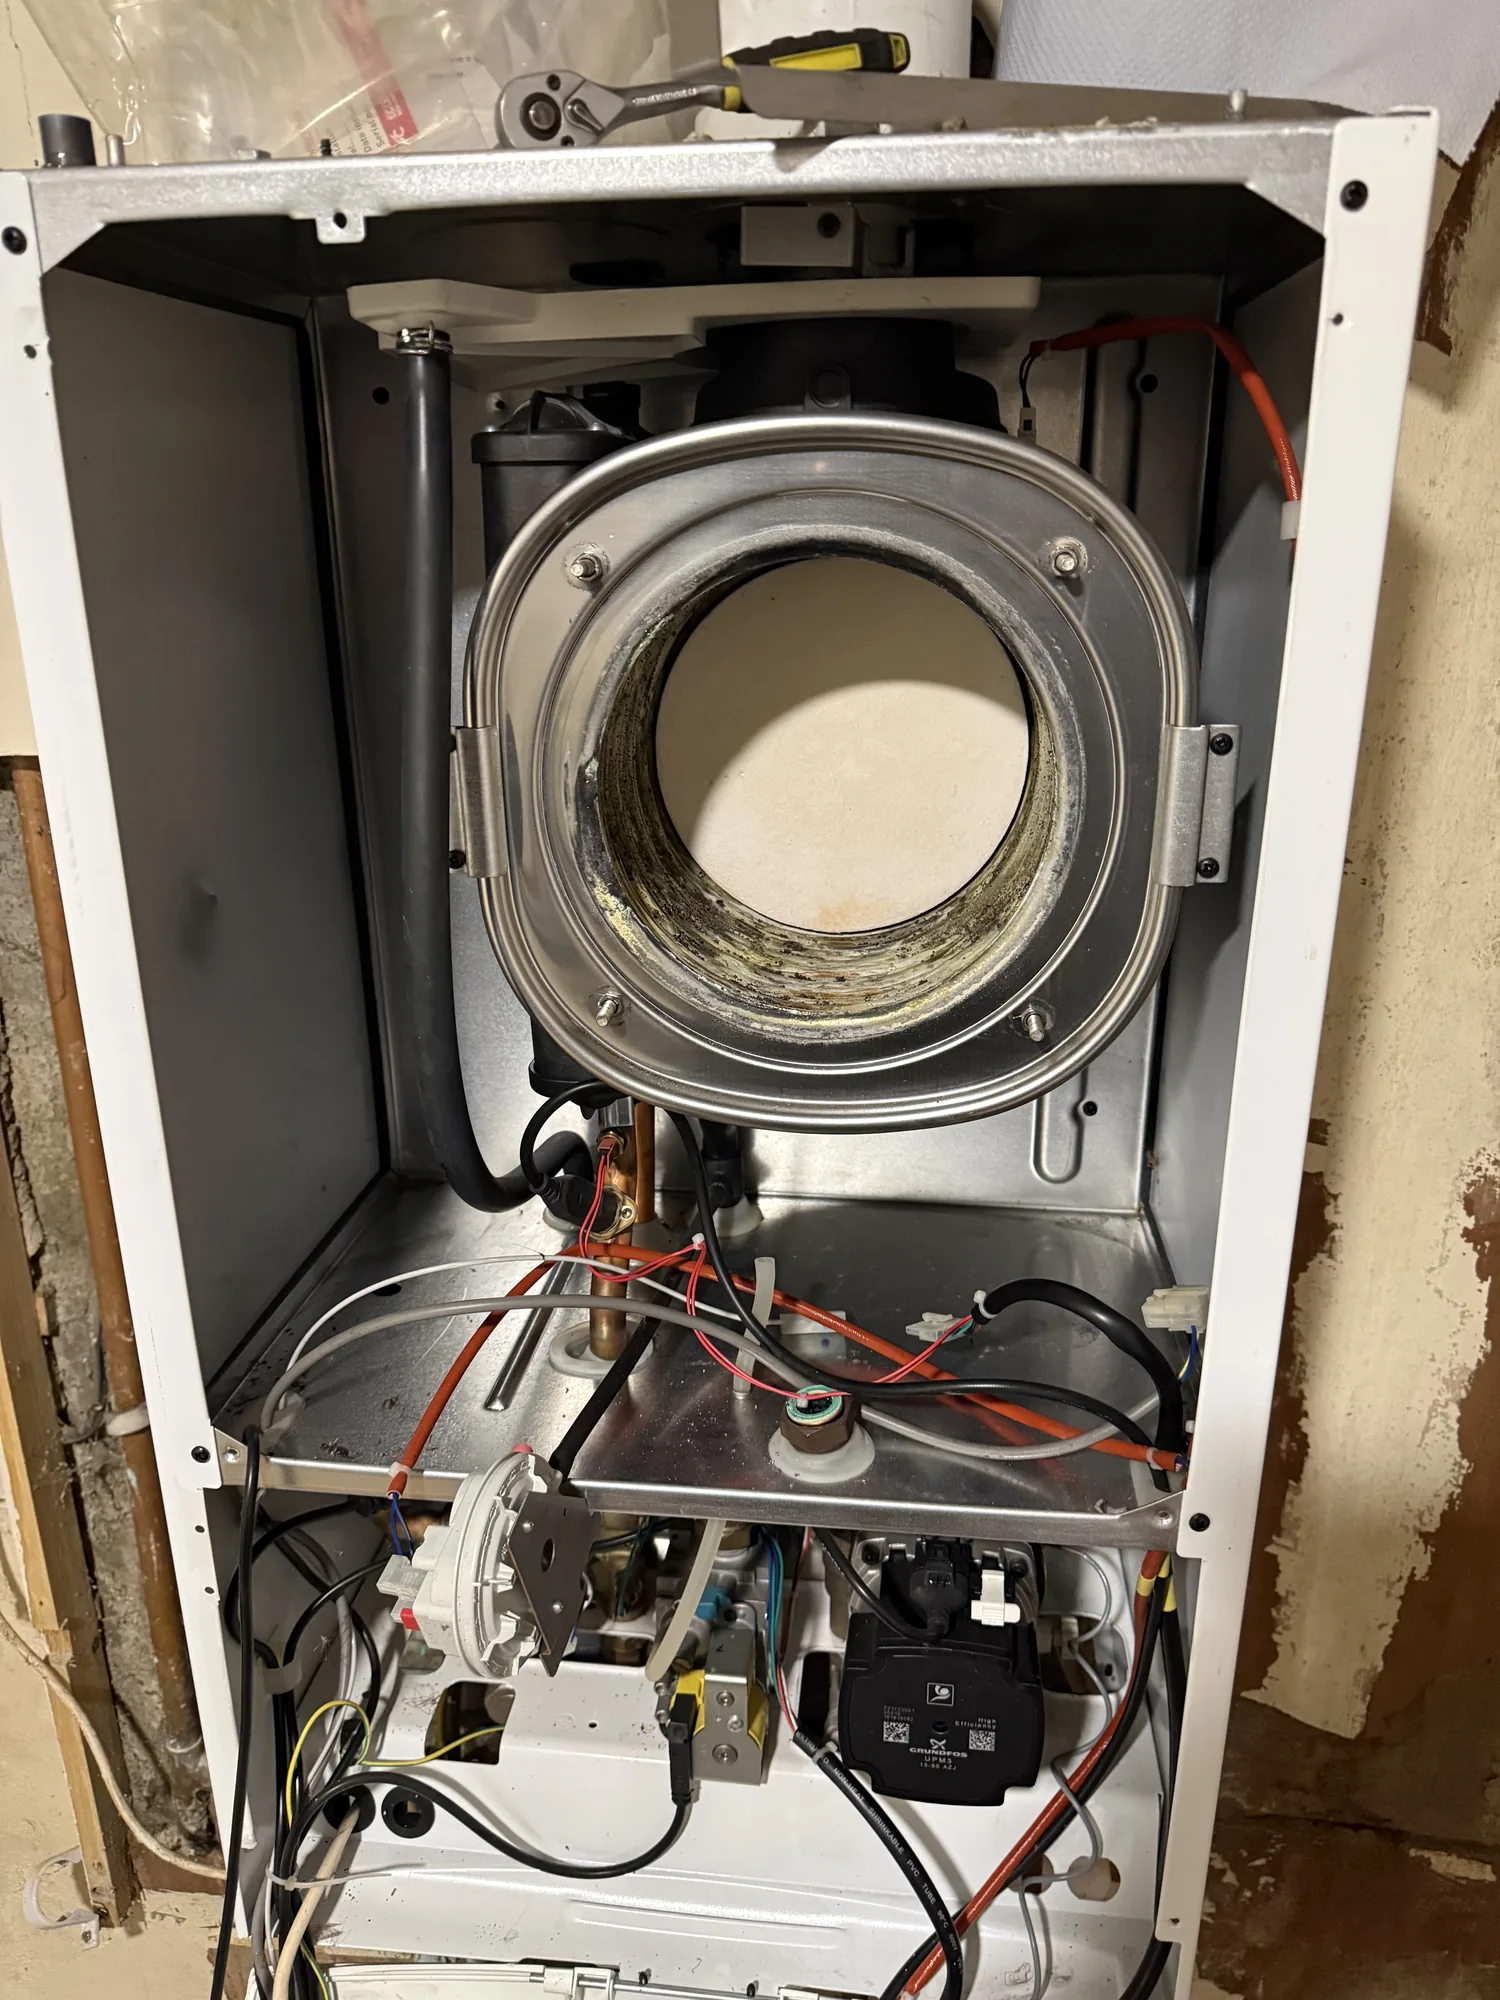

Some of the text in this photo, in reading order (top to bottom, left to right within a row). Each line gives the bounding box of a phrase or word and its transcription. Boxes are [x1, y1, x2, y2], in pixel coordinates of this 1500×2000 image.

[360, 132, 372, 153] Date
[954, 1720, 996, 1730] Efficiency
[978, 1717, 996, 1725] High
[909, 1747, 968, 1758] GRUNDFOS
[924, 1756, 952, 1764] UPM3
[796, 1731, 830, 1764] EXTRUD
[868, 1807, 905, 1854] SHRINKABLE
[906, 1859, 920, 1877] PVC
[922, 1882, 936, 1905] TUBE
